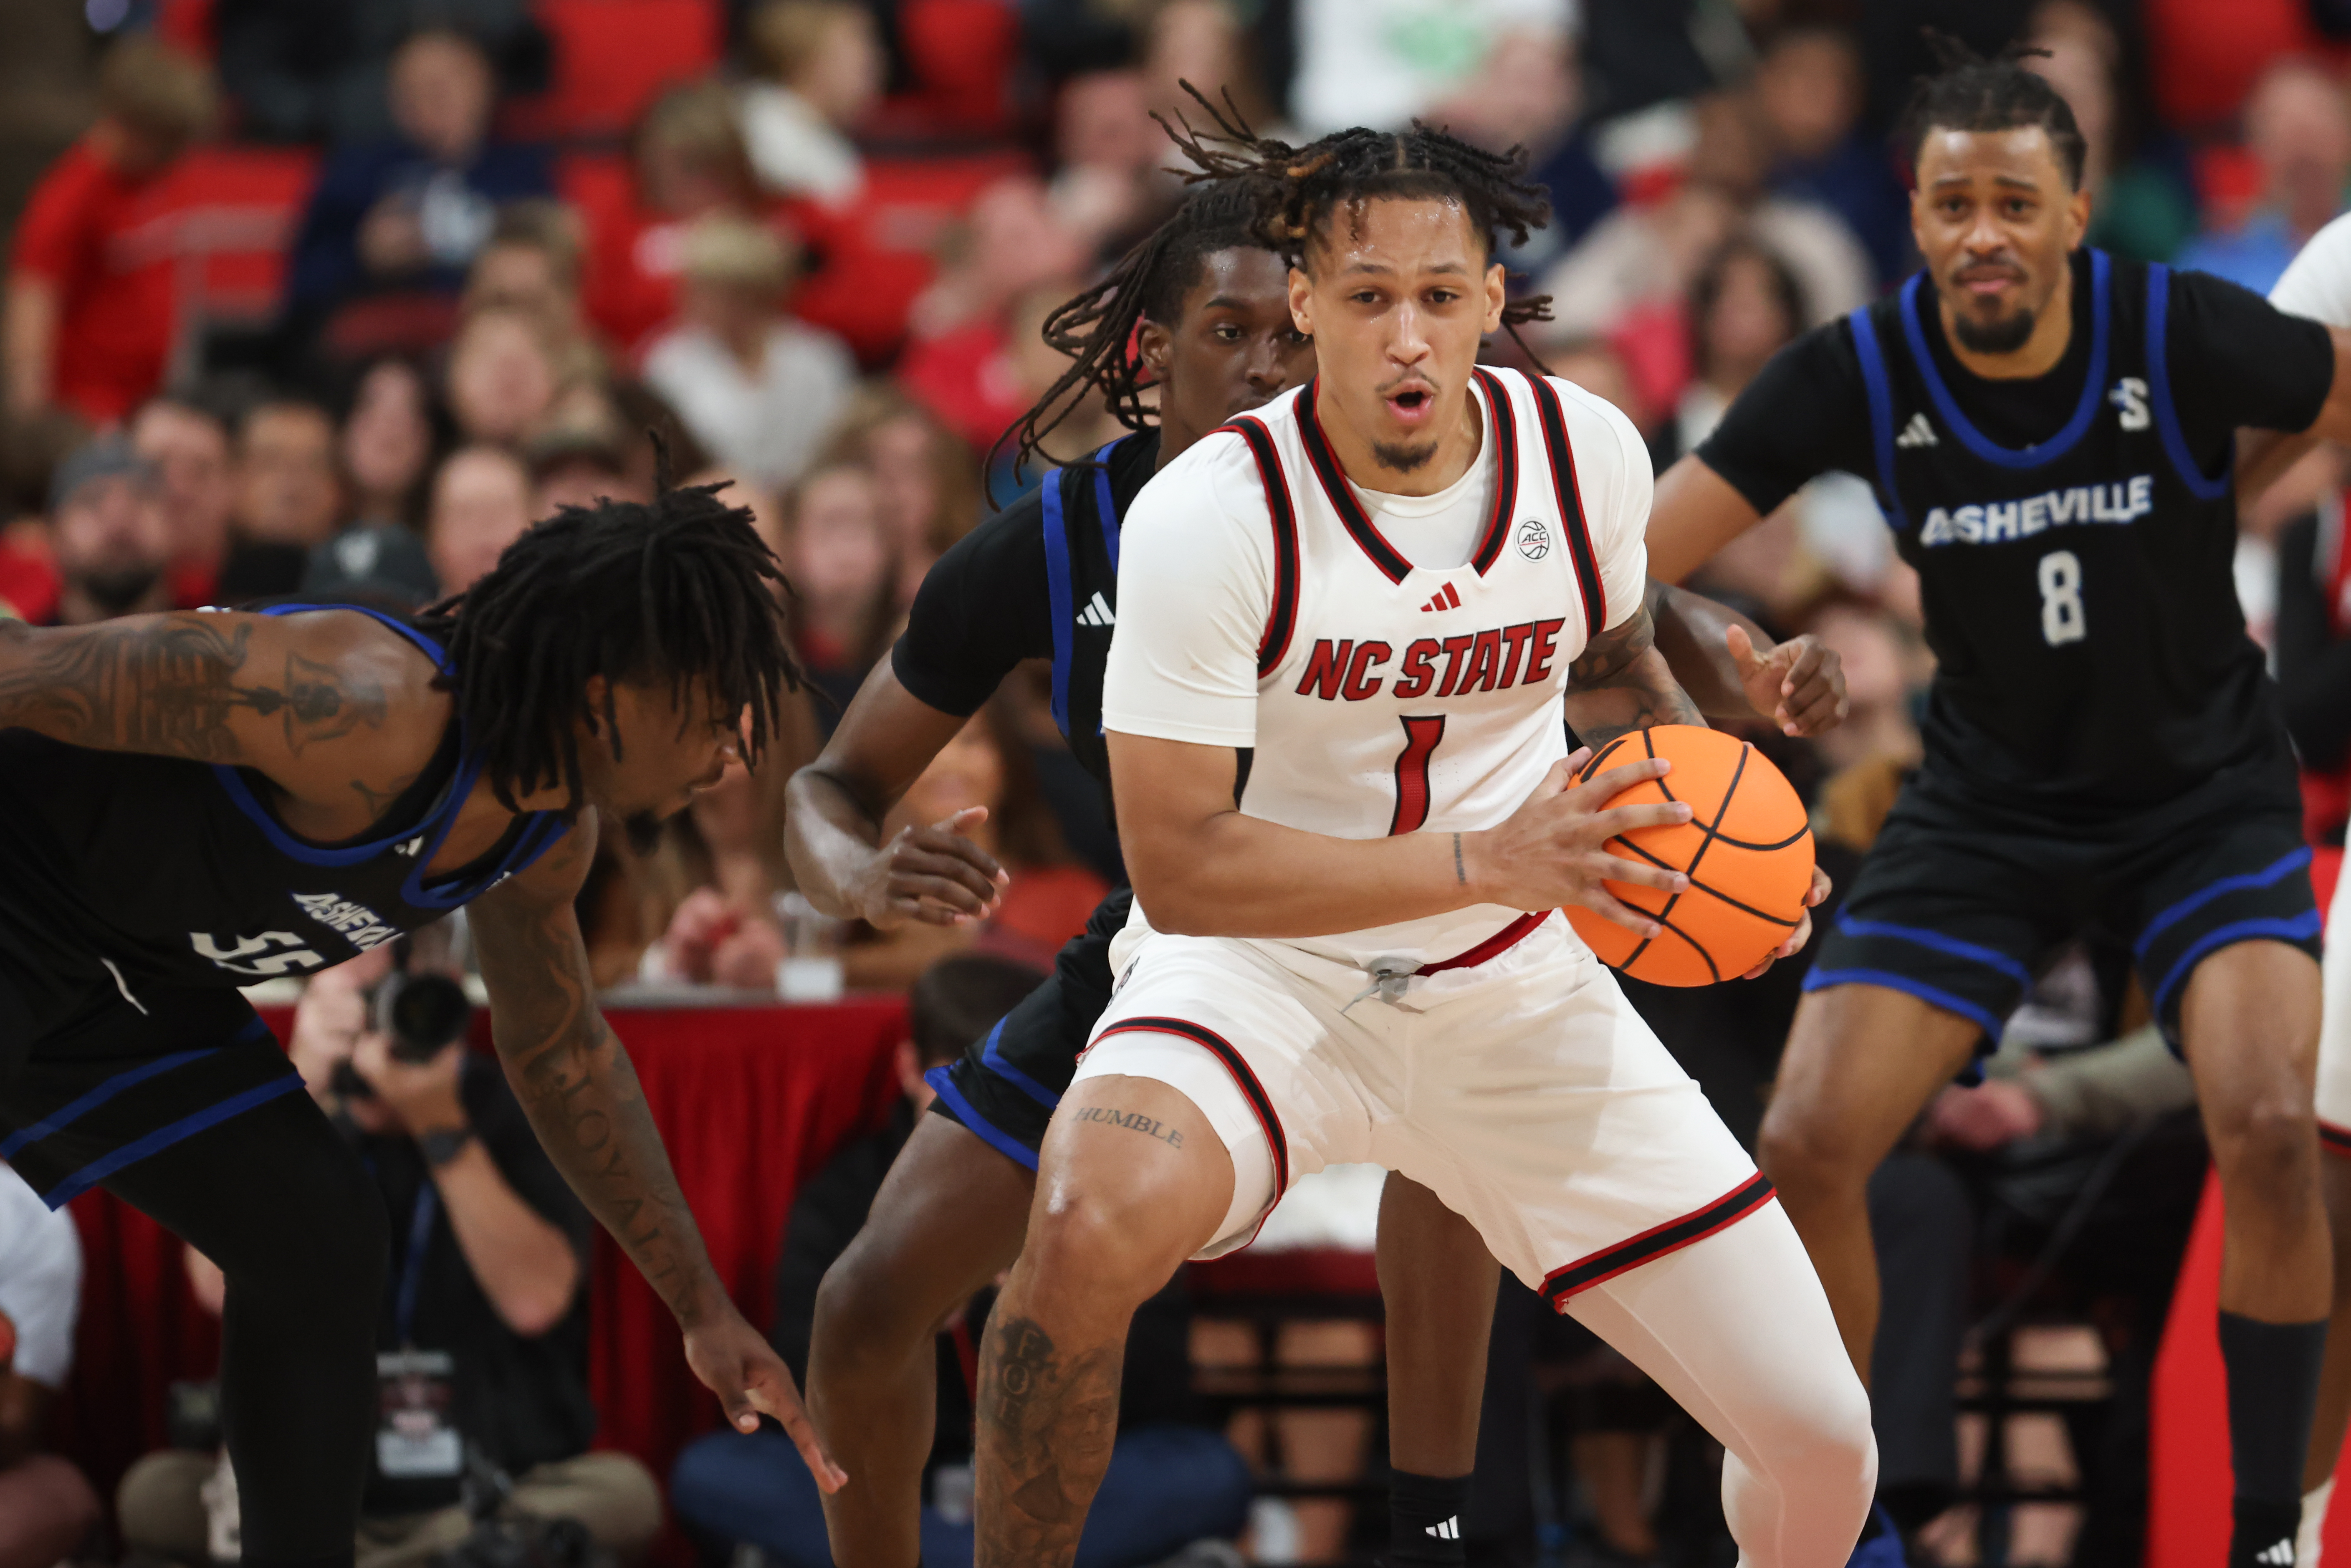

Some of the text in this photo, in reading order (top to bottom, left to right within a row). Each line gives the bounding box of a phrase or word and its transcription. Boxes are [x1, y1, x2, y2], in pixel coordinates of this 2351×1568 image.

[1522, 531, 1547, 543] ACC
[1919, 475, 2154, 547] ASHEVILLE
[2038, 550, 2086, 647] 8
[1295, 617, 1566, 701] NC STATE
[1387, 714, 1446, 837] 1
[1071, 1108, 1185, 1149] HUMBLE
